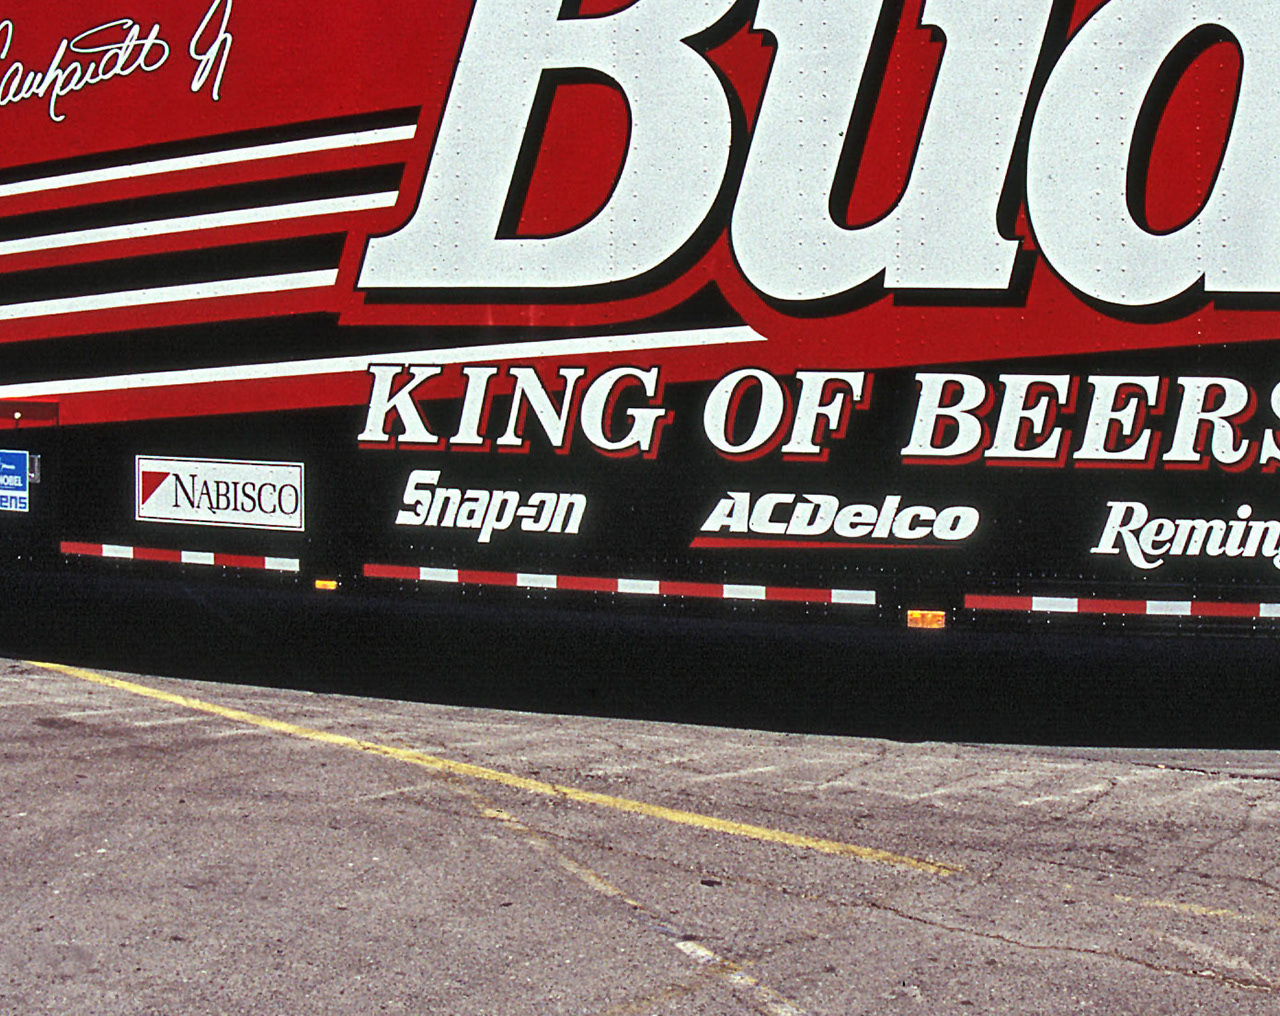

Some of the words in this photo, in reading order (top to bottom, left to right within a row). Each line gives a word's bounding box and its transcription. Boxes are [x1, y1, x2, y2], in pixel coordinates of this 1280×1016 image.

[357, 364, 670, 456] KING
[703, 367, 869, 458] OF
[172, 473, 299, 515] NABISCO
[395, 469, 588, 543] Snap-on
[699, 491, 981, 542] ACDelco
